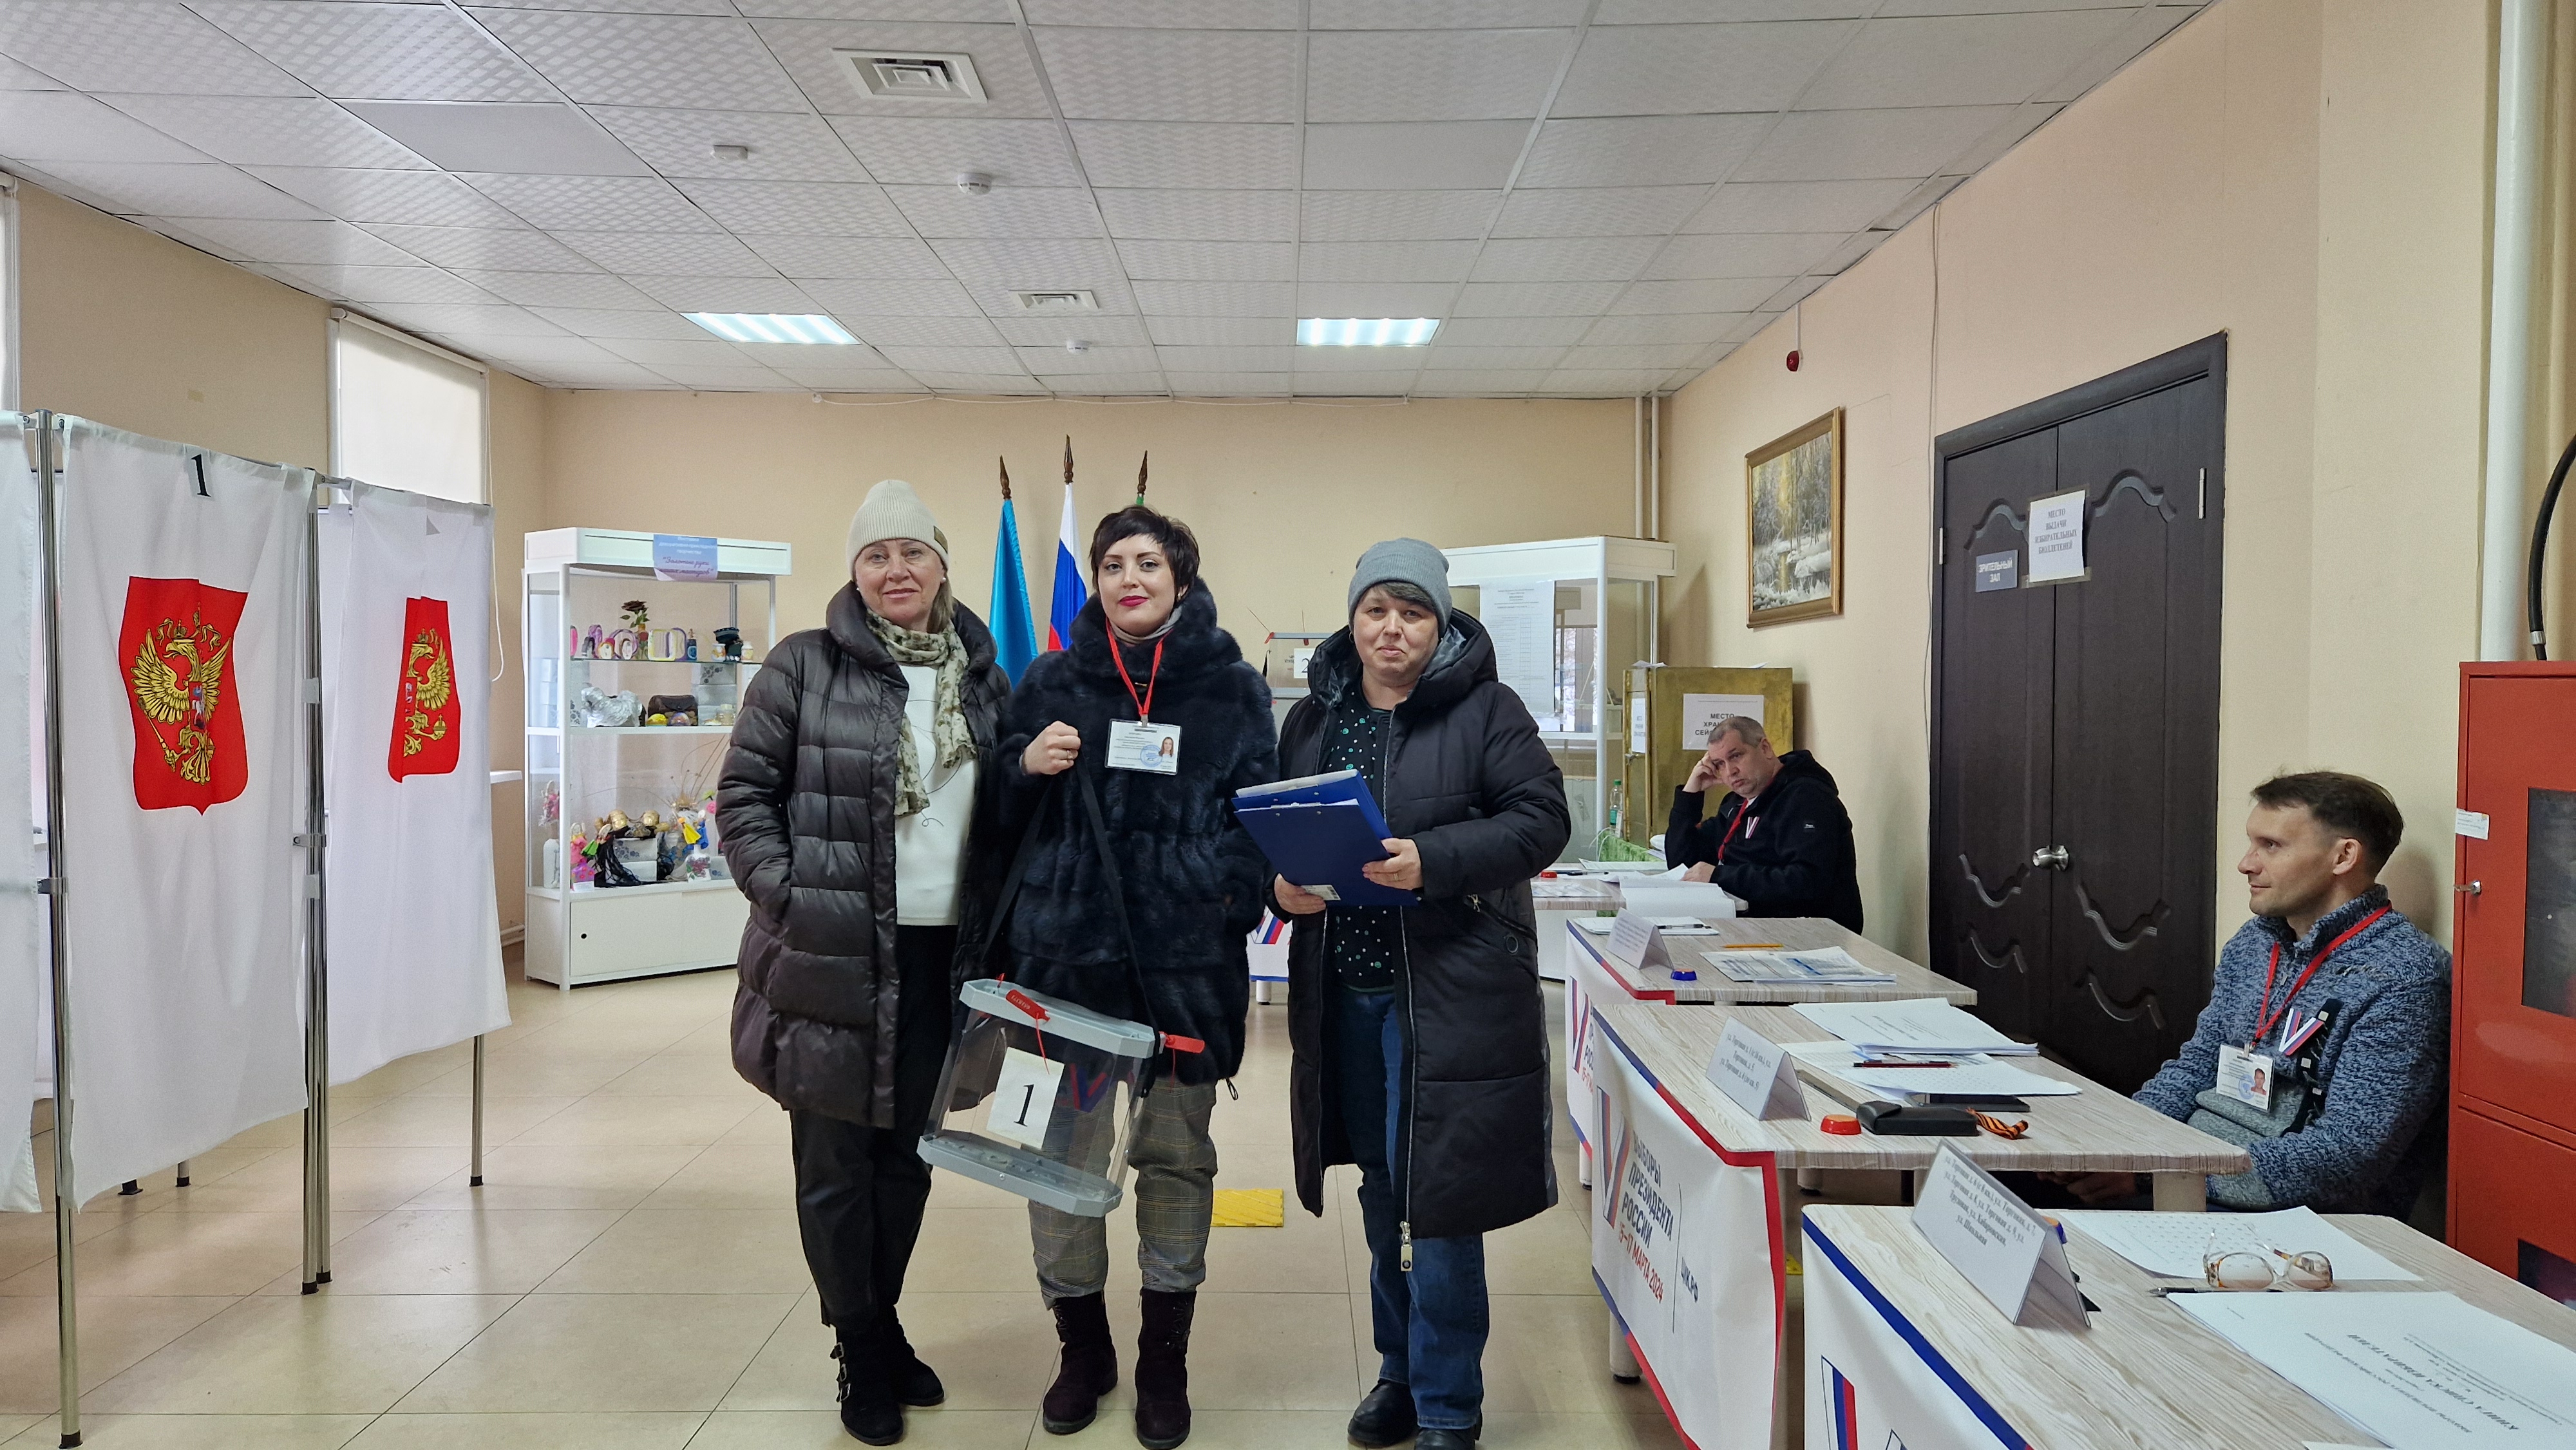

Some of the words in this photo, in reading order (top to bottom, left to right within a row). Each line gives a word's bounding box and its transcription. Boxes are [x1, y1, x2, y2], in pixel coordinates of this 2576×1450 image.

[191, 454, 211, 497] 1
[2048, 508, 2066, 518] МЕСТО
[2045, 520, 2067, 531] ВЫДАЧИ
[2035, 529, 2077, 543] ИЗБИРАТЕЛЬНЫХ
[2038, 541, 2073, 554] БЮЛЛЕТЕНЕЙ
[1978, 558, 2013, 573] ЗРИТЕЛЬНЫЙ
[1989, 572, 2001, 583] ЗАЛ
[1302, 658, 1309, 673] 2
[1013, 1084, 1034, 1127] 1
[1633, 1129, 1661, 1188] ВЫБОРЫ
[1628, 1161, 1674, 1241] ПРЕЗИДЕНТА
[1622, 1191, 1653, 1248] РОССИИ
[1632, 1240, 1649, 1283] МАРТА
[1649, 1268, 1663, 1304] 2024
